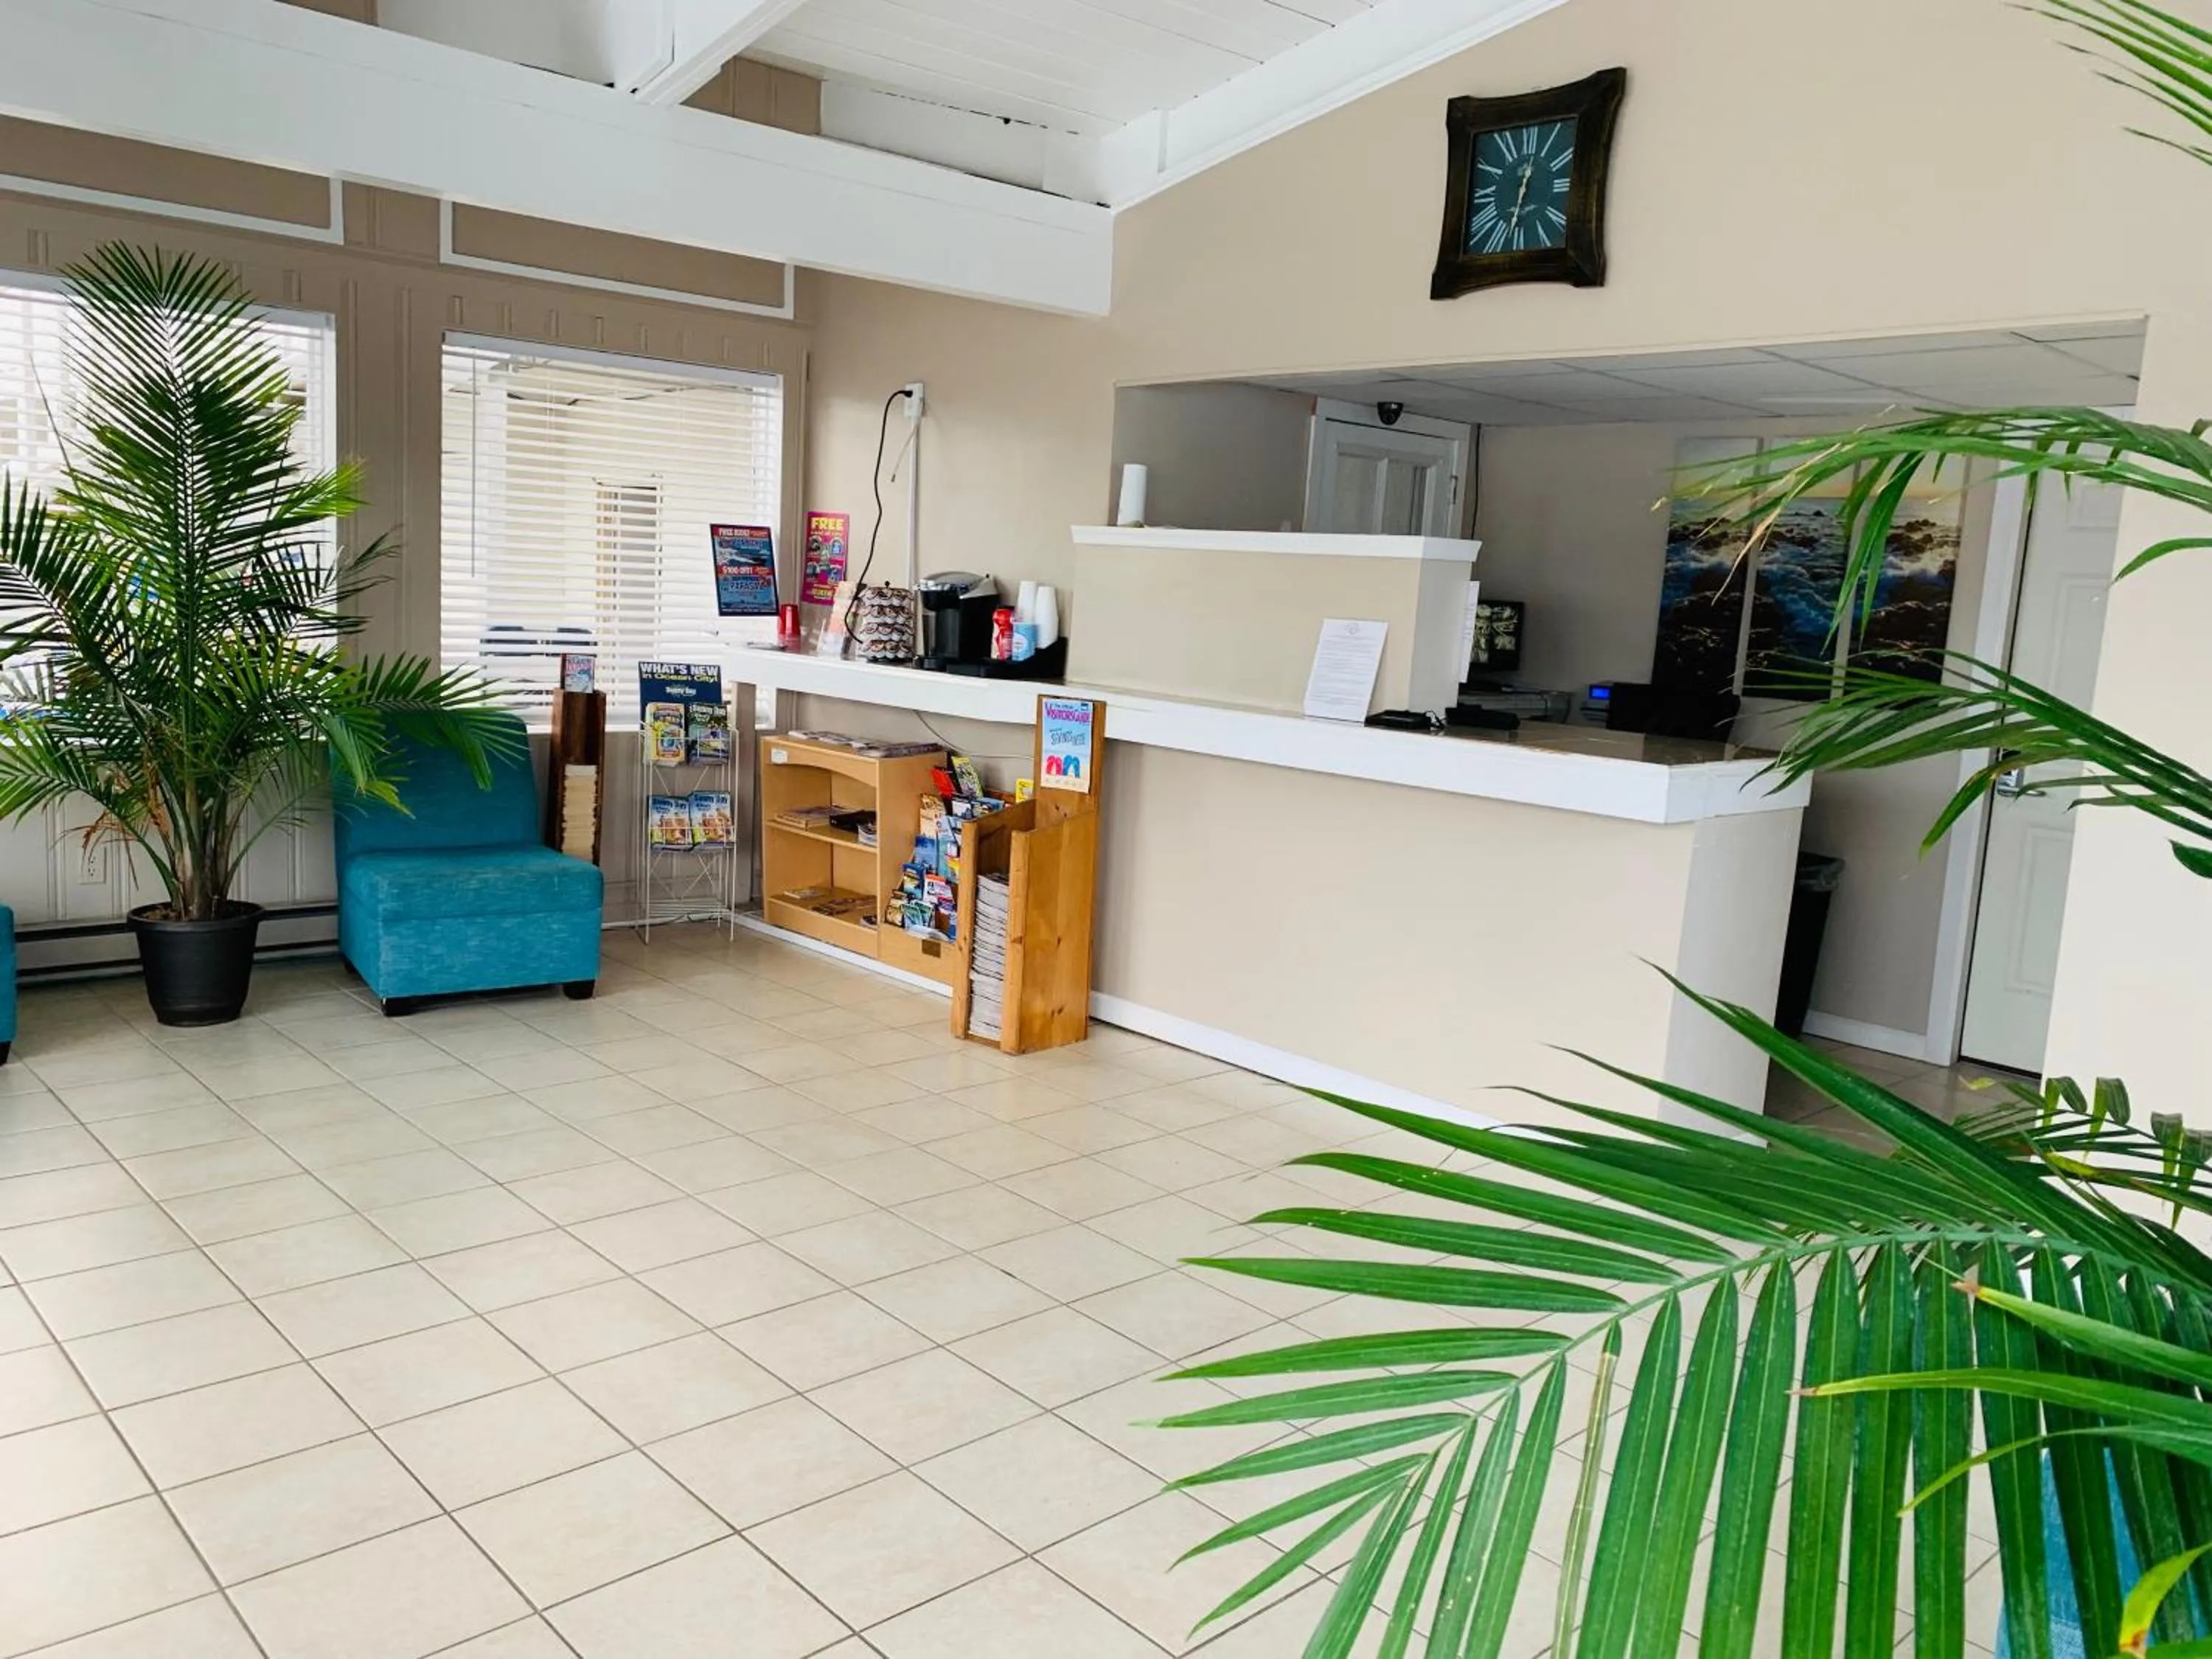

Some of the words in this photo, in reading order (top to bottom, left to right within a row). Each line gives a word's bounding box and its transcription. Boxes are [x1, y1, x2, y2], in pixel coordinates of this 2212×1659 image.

[1520, 126, 1539, 154] XII
[1549, 147, 1575, 172] II
[1552, 177, 1571, 193] III
[1474, 185, 1498, 204] IX
[812, 517, 843, 530] FREE
[640, 663, 688, 675] WHAT'S
[691, 665, 719, 676] NEW
[655, 673, 692, 681] Ocean
[695, 675, 718, 684] City!
